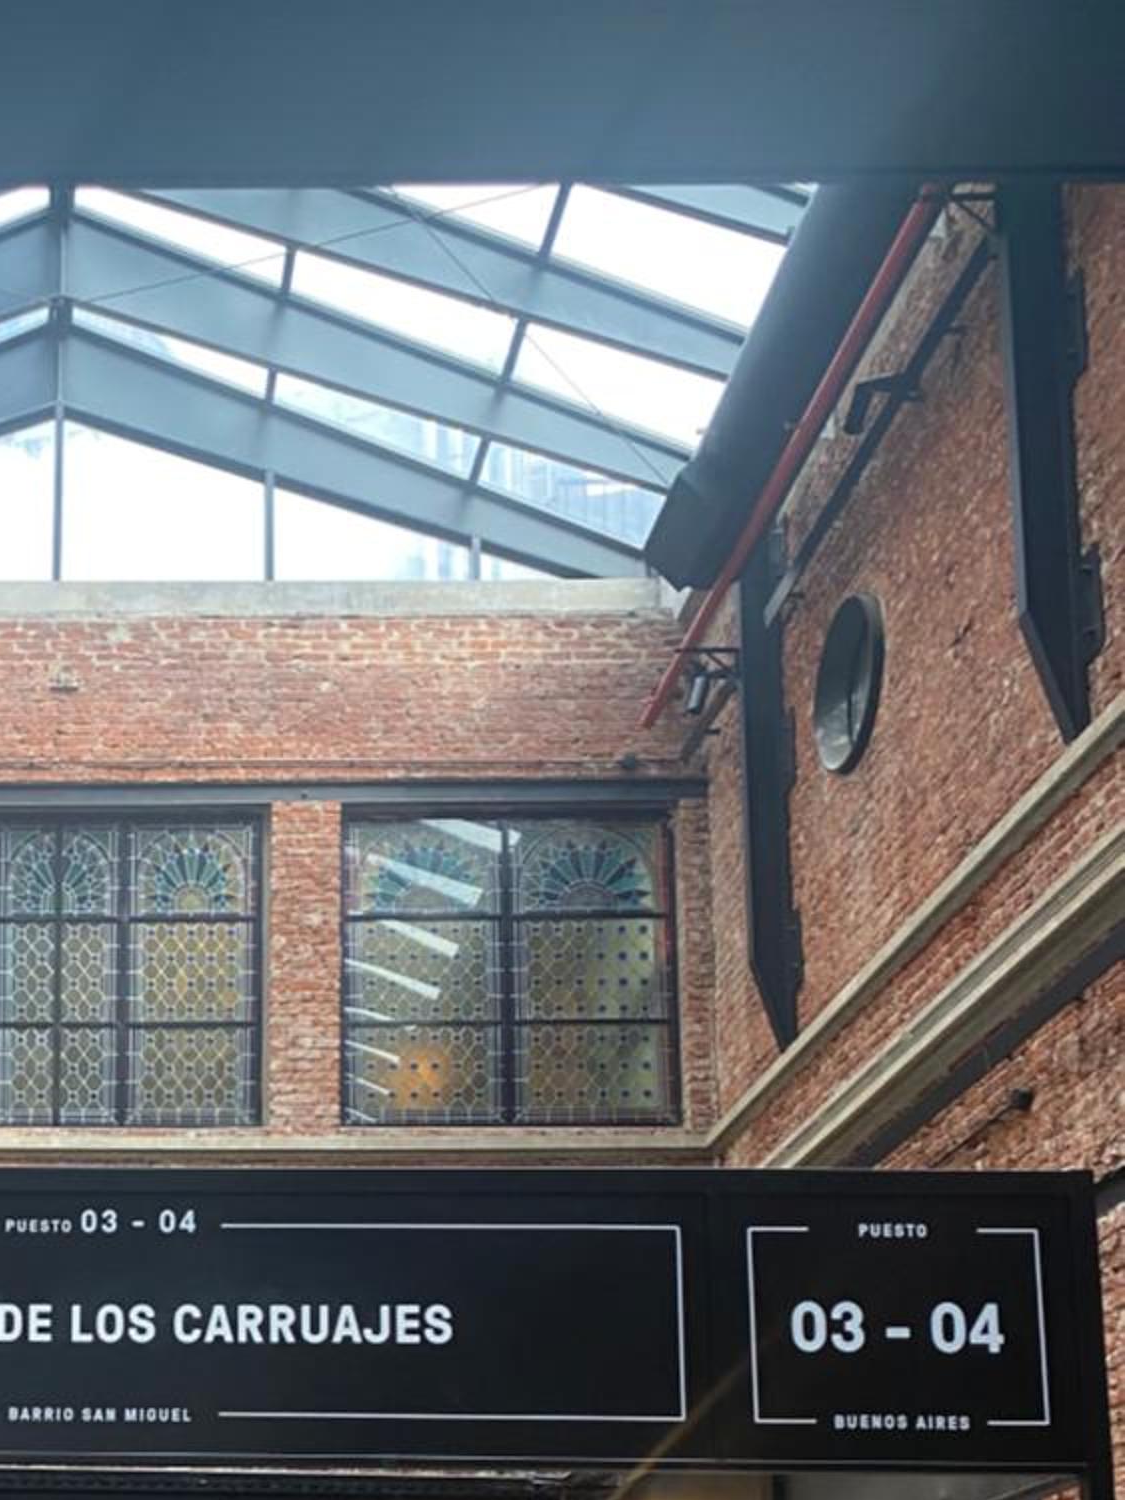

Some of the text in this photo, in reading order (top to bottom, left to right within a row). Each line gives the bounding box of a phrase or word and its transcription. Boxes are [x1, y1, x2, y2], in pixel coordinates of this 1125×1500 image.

[5, 1218, 72, 1233] PUESTO
[80, 1209, 118, 1234] 03
[158, 1209, 196, 1234] 04
[858, 1223, 927, 1238] PUESTO
[70, 1302, 156, 1344] LOS
[173, 1303, 453, 1345] CARRUAJES
[791, 1301, 865, 1353] 03
[931, 1303, 1005, 1354] 04
[8, 1406, 192, 1423] BARRIO SAN MIGUEL
[834, 1414, 970, 1430] BUENOS AIRES
